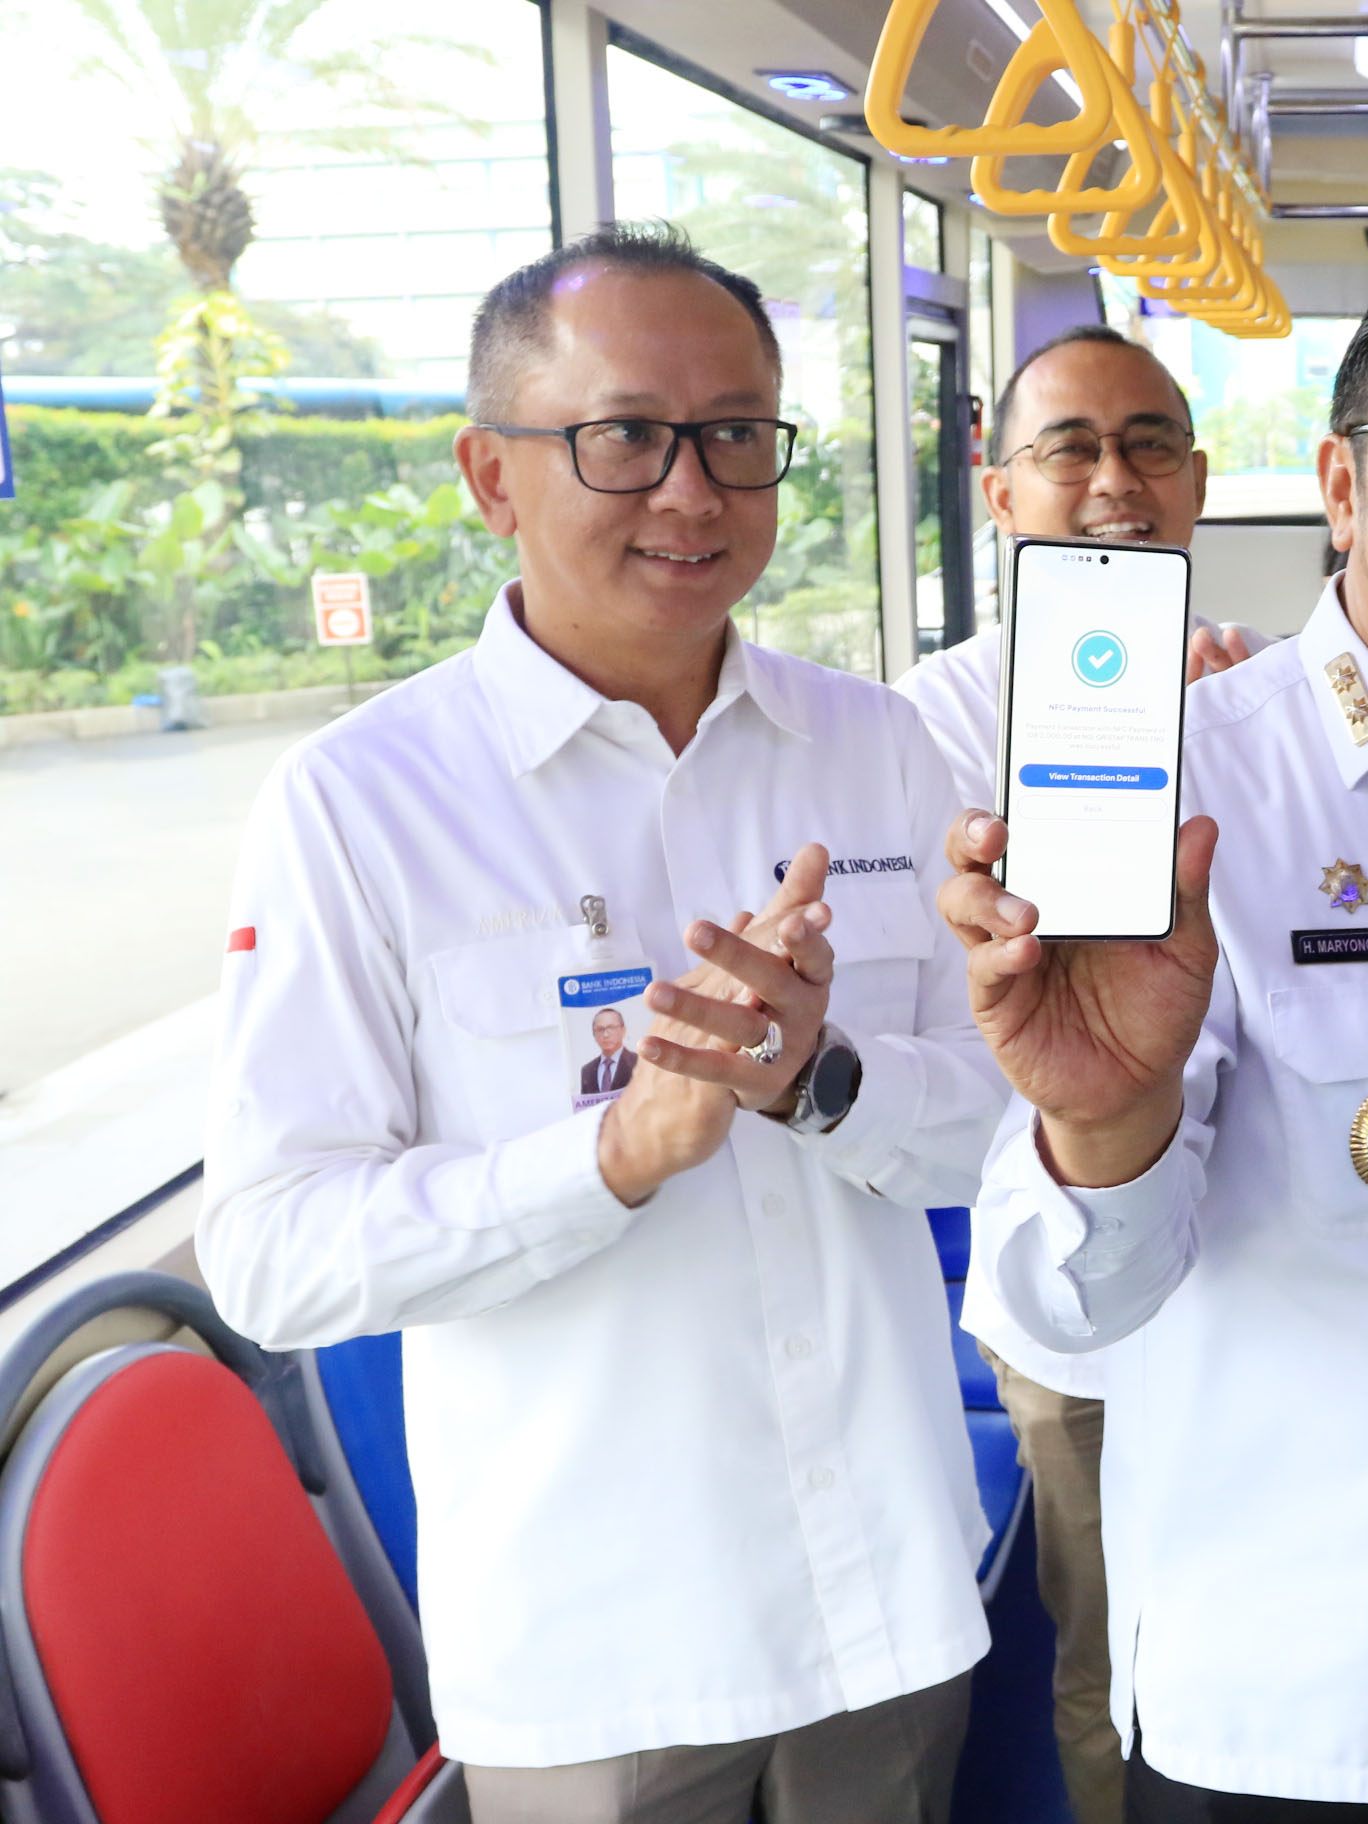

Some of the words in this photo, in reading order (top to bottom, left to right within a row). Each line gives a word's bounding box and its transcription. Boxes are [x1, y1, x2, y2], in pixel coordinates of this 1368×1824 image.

[1067, 705, 1101, 713] Payment
[1103, 705, 1146, 714] Successful
[1048, 772, 1069, 780] View
[1070, 773, 1115, 781] Transaction
[1116, 774, 1141, 782] Detail
[1303, 940, 1315, 954] H.
[581, 980, 602, 989] BANK
[603, 976, 646, 987] INDONESIA
